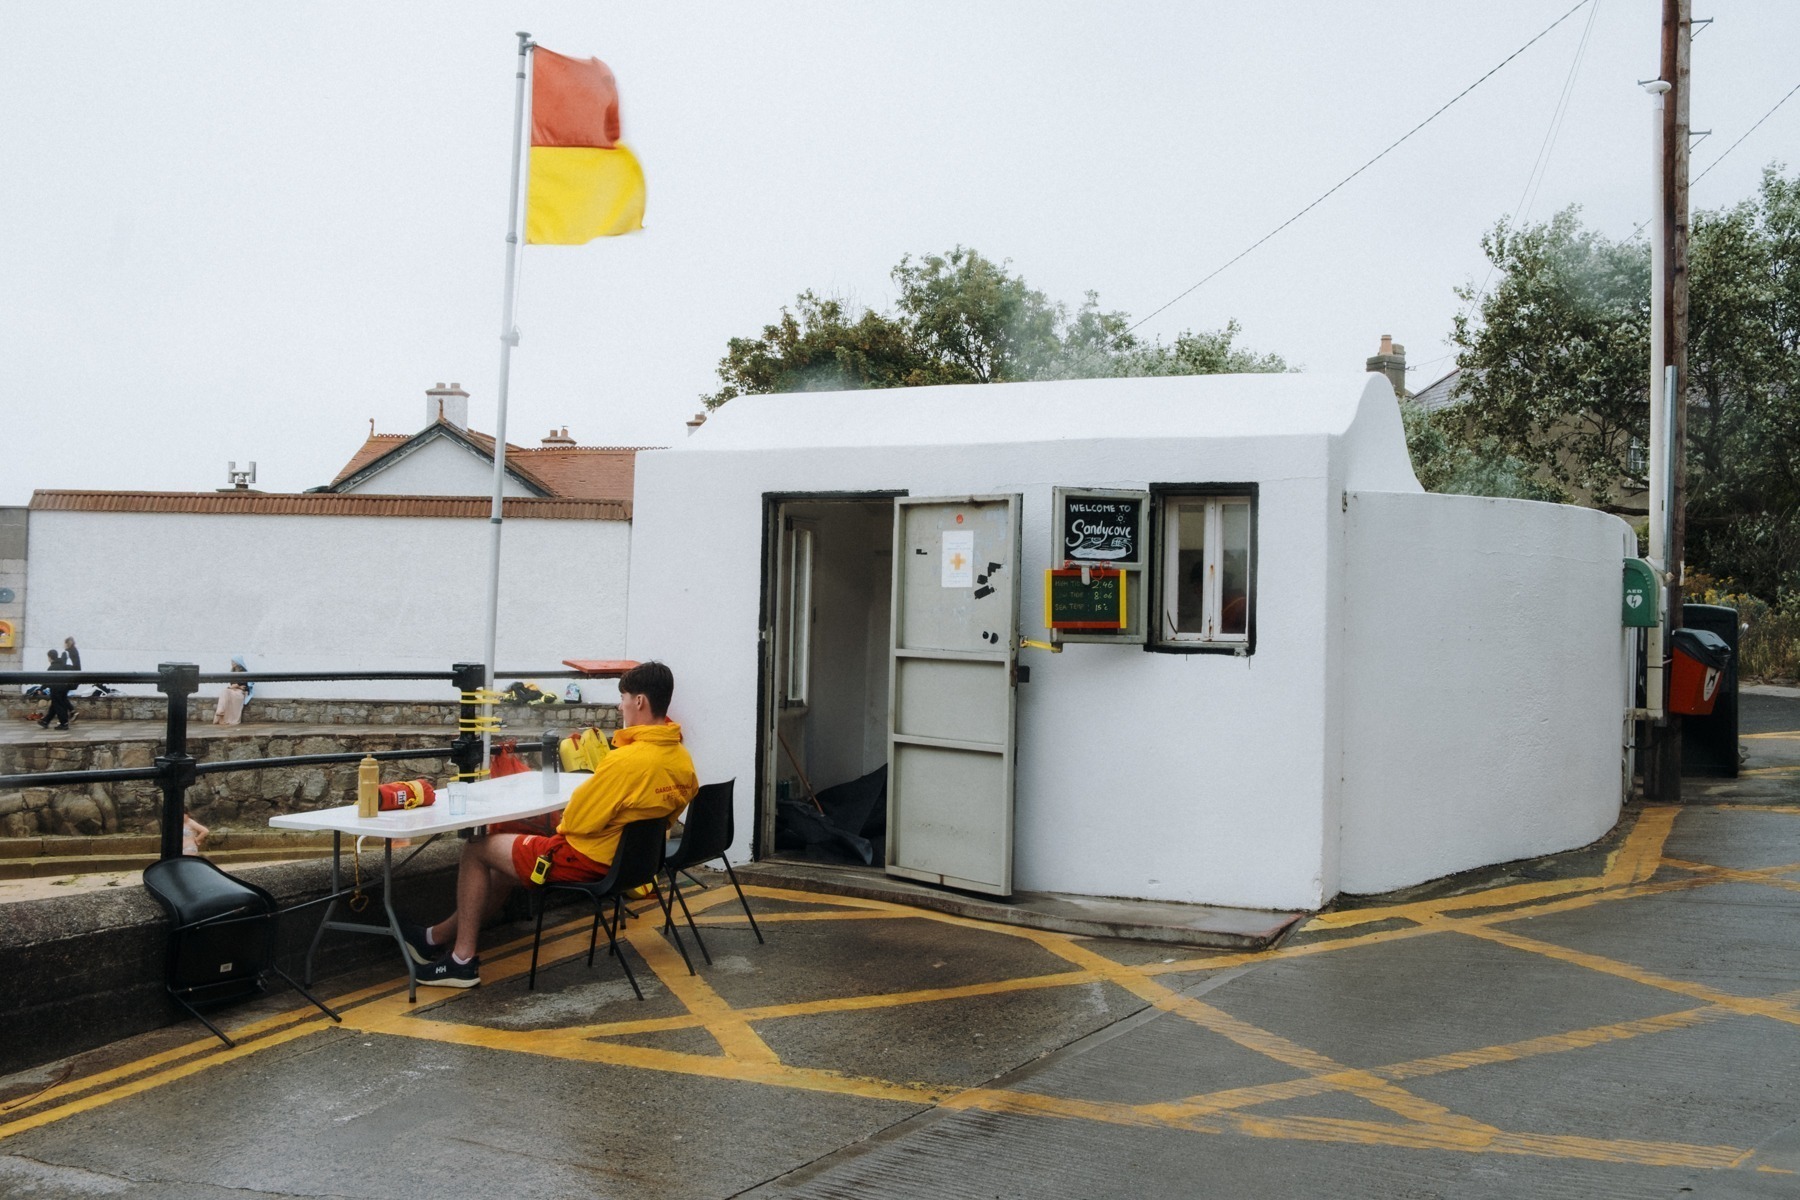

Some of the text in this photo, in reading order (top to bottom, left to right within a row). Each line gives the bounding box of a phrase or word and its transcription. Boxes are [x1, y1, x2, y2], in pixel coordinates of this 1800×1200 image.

[1070, 504, 1131, 513] WELCOME TO
[1065, 518, 1132, 548] Sandycove
[435, 965, 447, 974] HH
